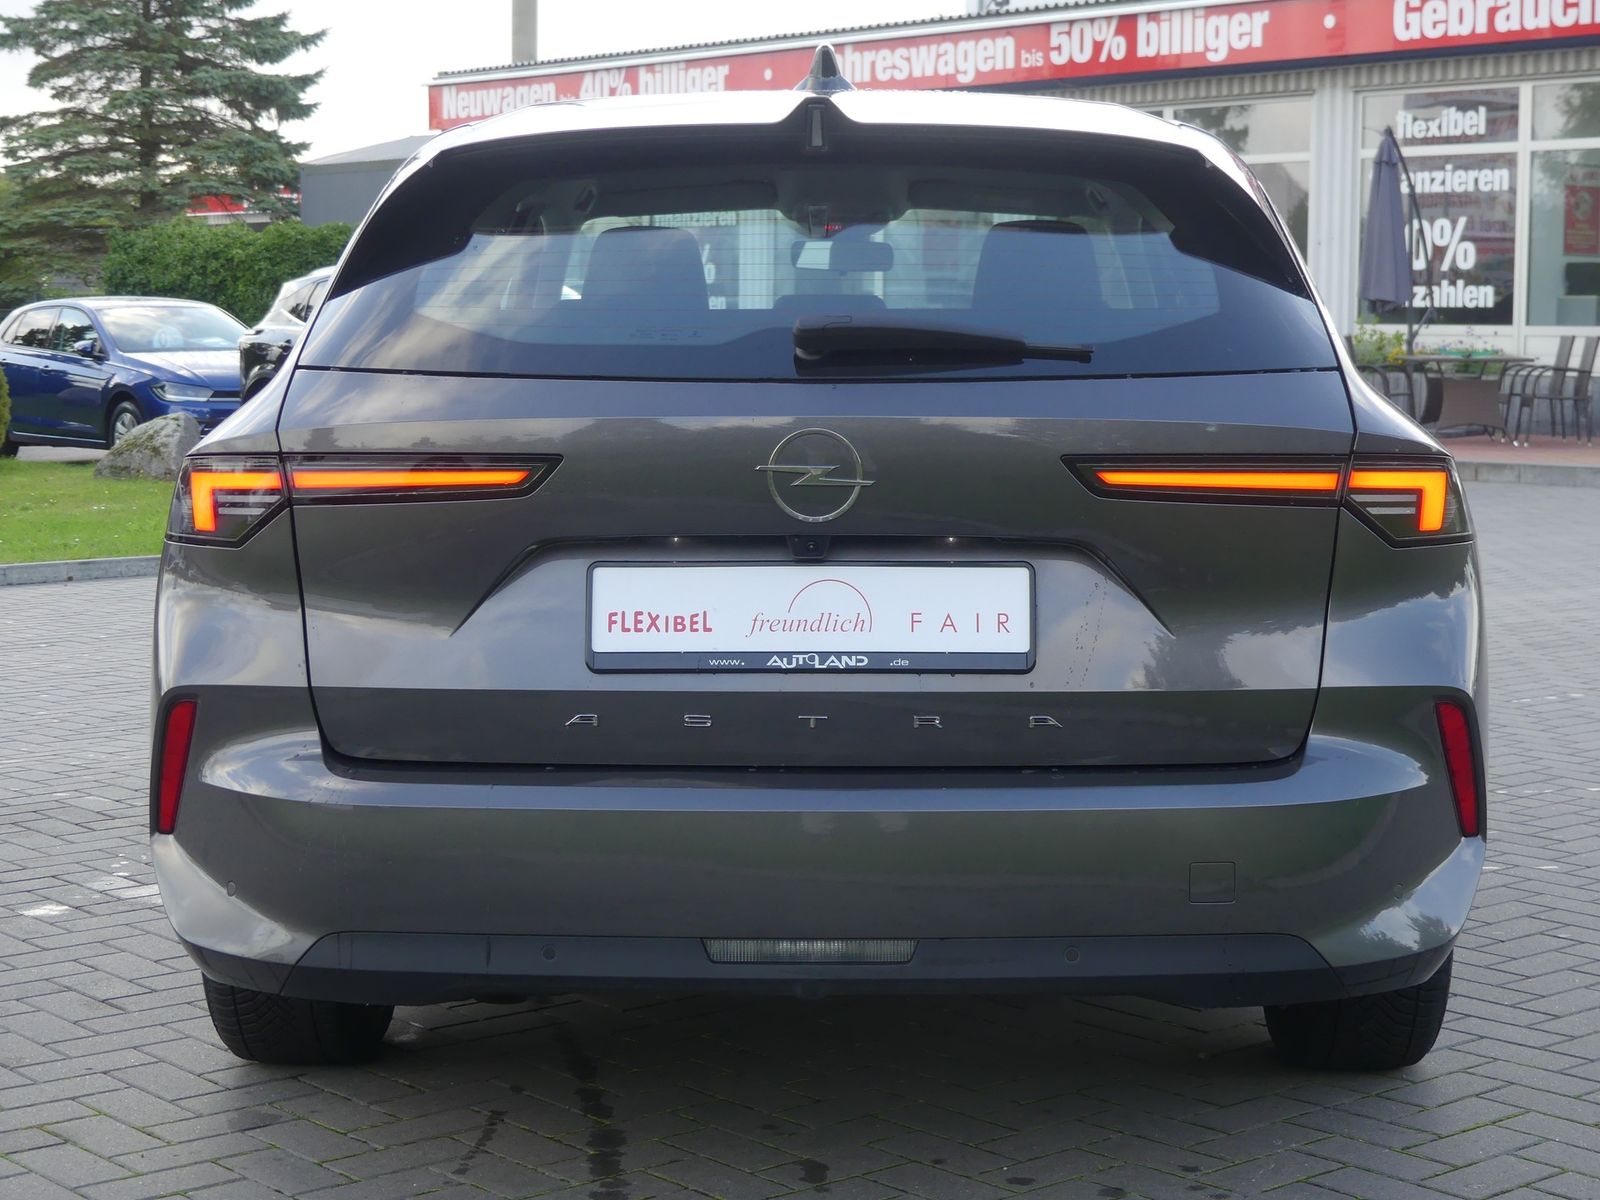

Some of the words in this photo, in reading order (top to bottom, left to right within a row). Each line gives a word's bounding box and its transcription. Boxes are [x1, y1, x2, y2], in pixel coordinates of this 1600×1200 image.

[441, 82, 557, 119] Neuwagen
[579, 67, 632, 98] 40%
[637, 62, 730, 95] billiger
[836, 34, 1017, 84] hreswagen
[1020, 50, 1044, 68] bis
[1049, 16, 1127, 66] 50%
[1136, 7, 1270, 62] billiger
[1396, 105, 1488, 139] flexibel
[1400, 164, 1510, 194] anzieren
[607, 610, 714, 634] FLEXIBEL
[745, 611, 867, 638] freundlich
[911, 611, 1012, 634] FAIR
[708, 658, 745, 667] www.
[766, 652, 869, 669] AUTOLAND
[889, 658, 910, 667] .de
[564, 712, 1064, 728] ASTRA
